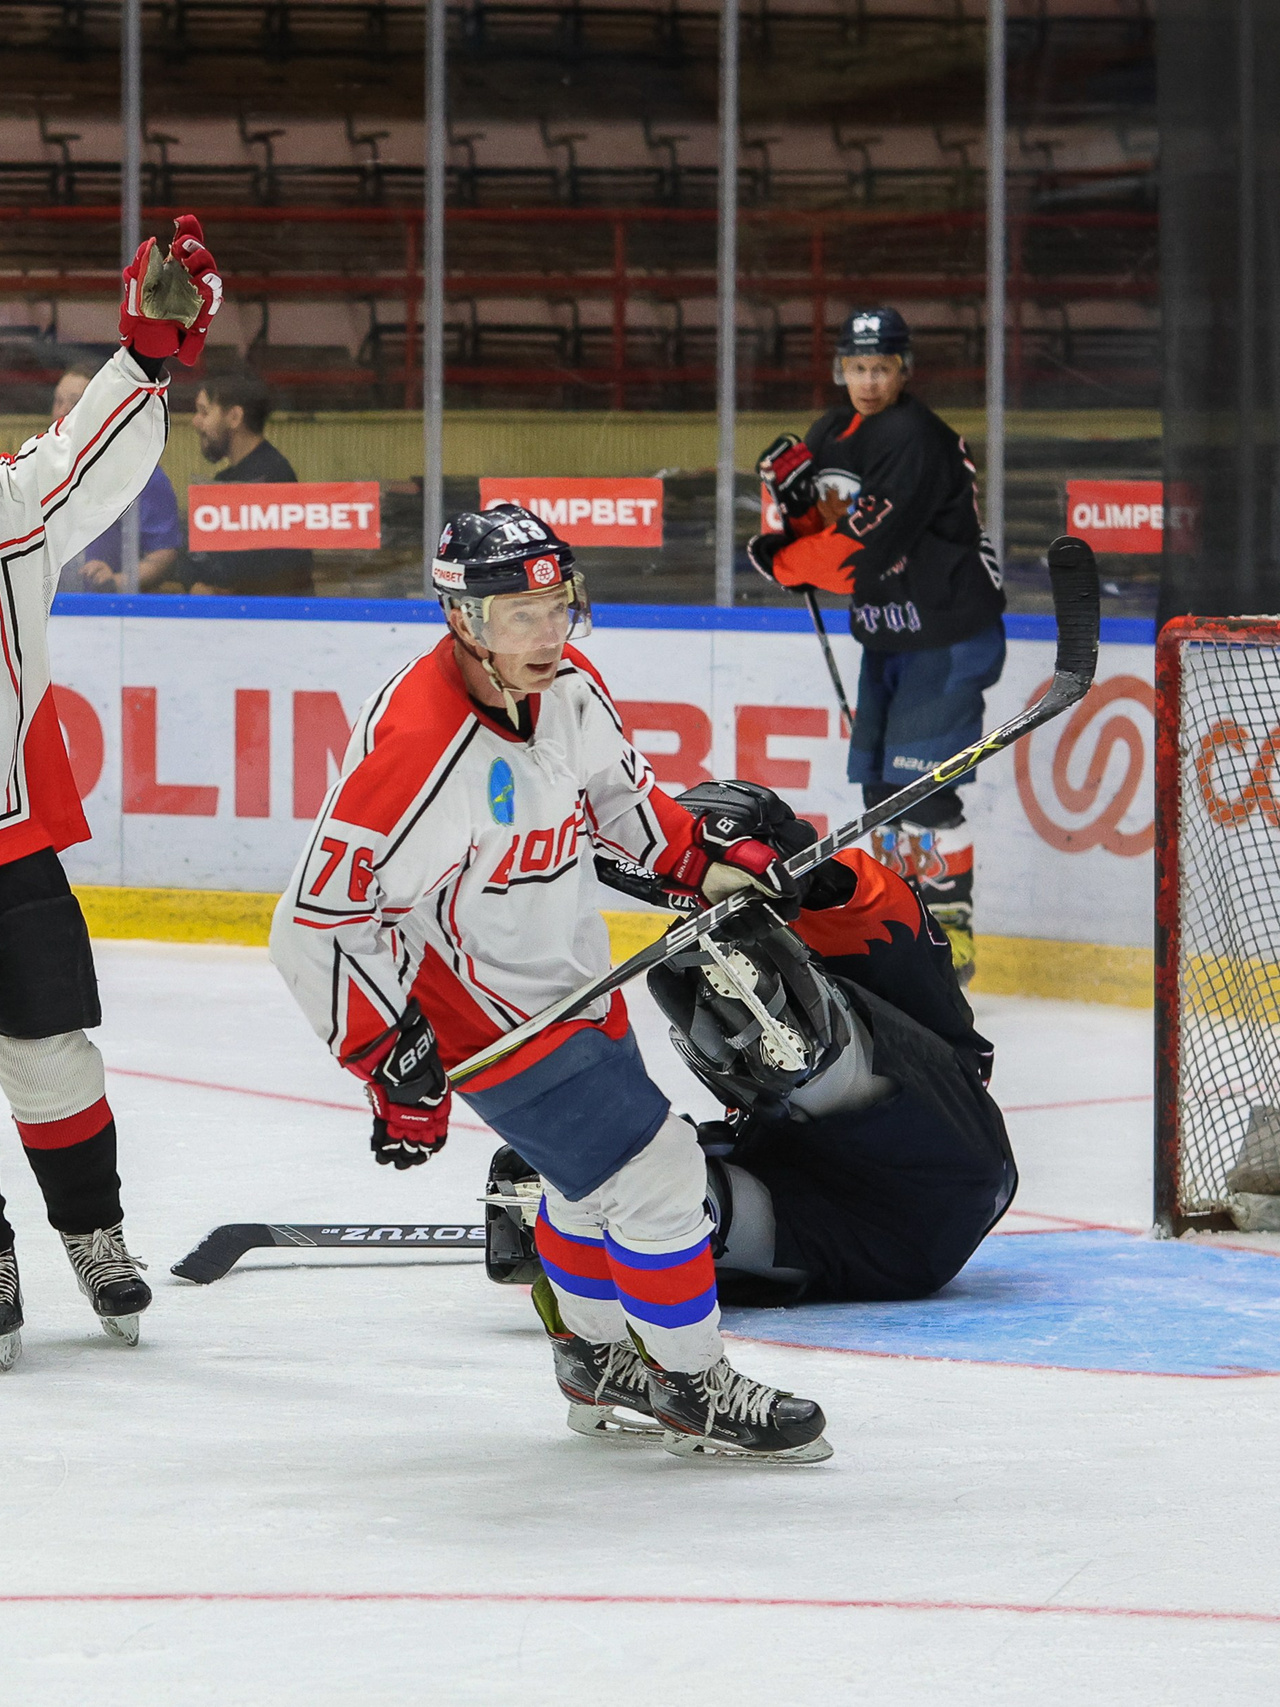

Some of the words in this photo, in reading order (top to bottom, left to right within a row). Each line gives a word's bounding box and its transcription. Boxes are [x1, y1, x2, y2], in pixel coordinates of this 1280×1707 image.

[193, 503, 375, 532] OLIMPBET
[485, 498, 658, 526] IMPBET
[502, 519, 548, 545] 43
[309, 836, 374, 902] 76
